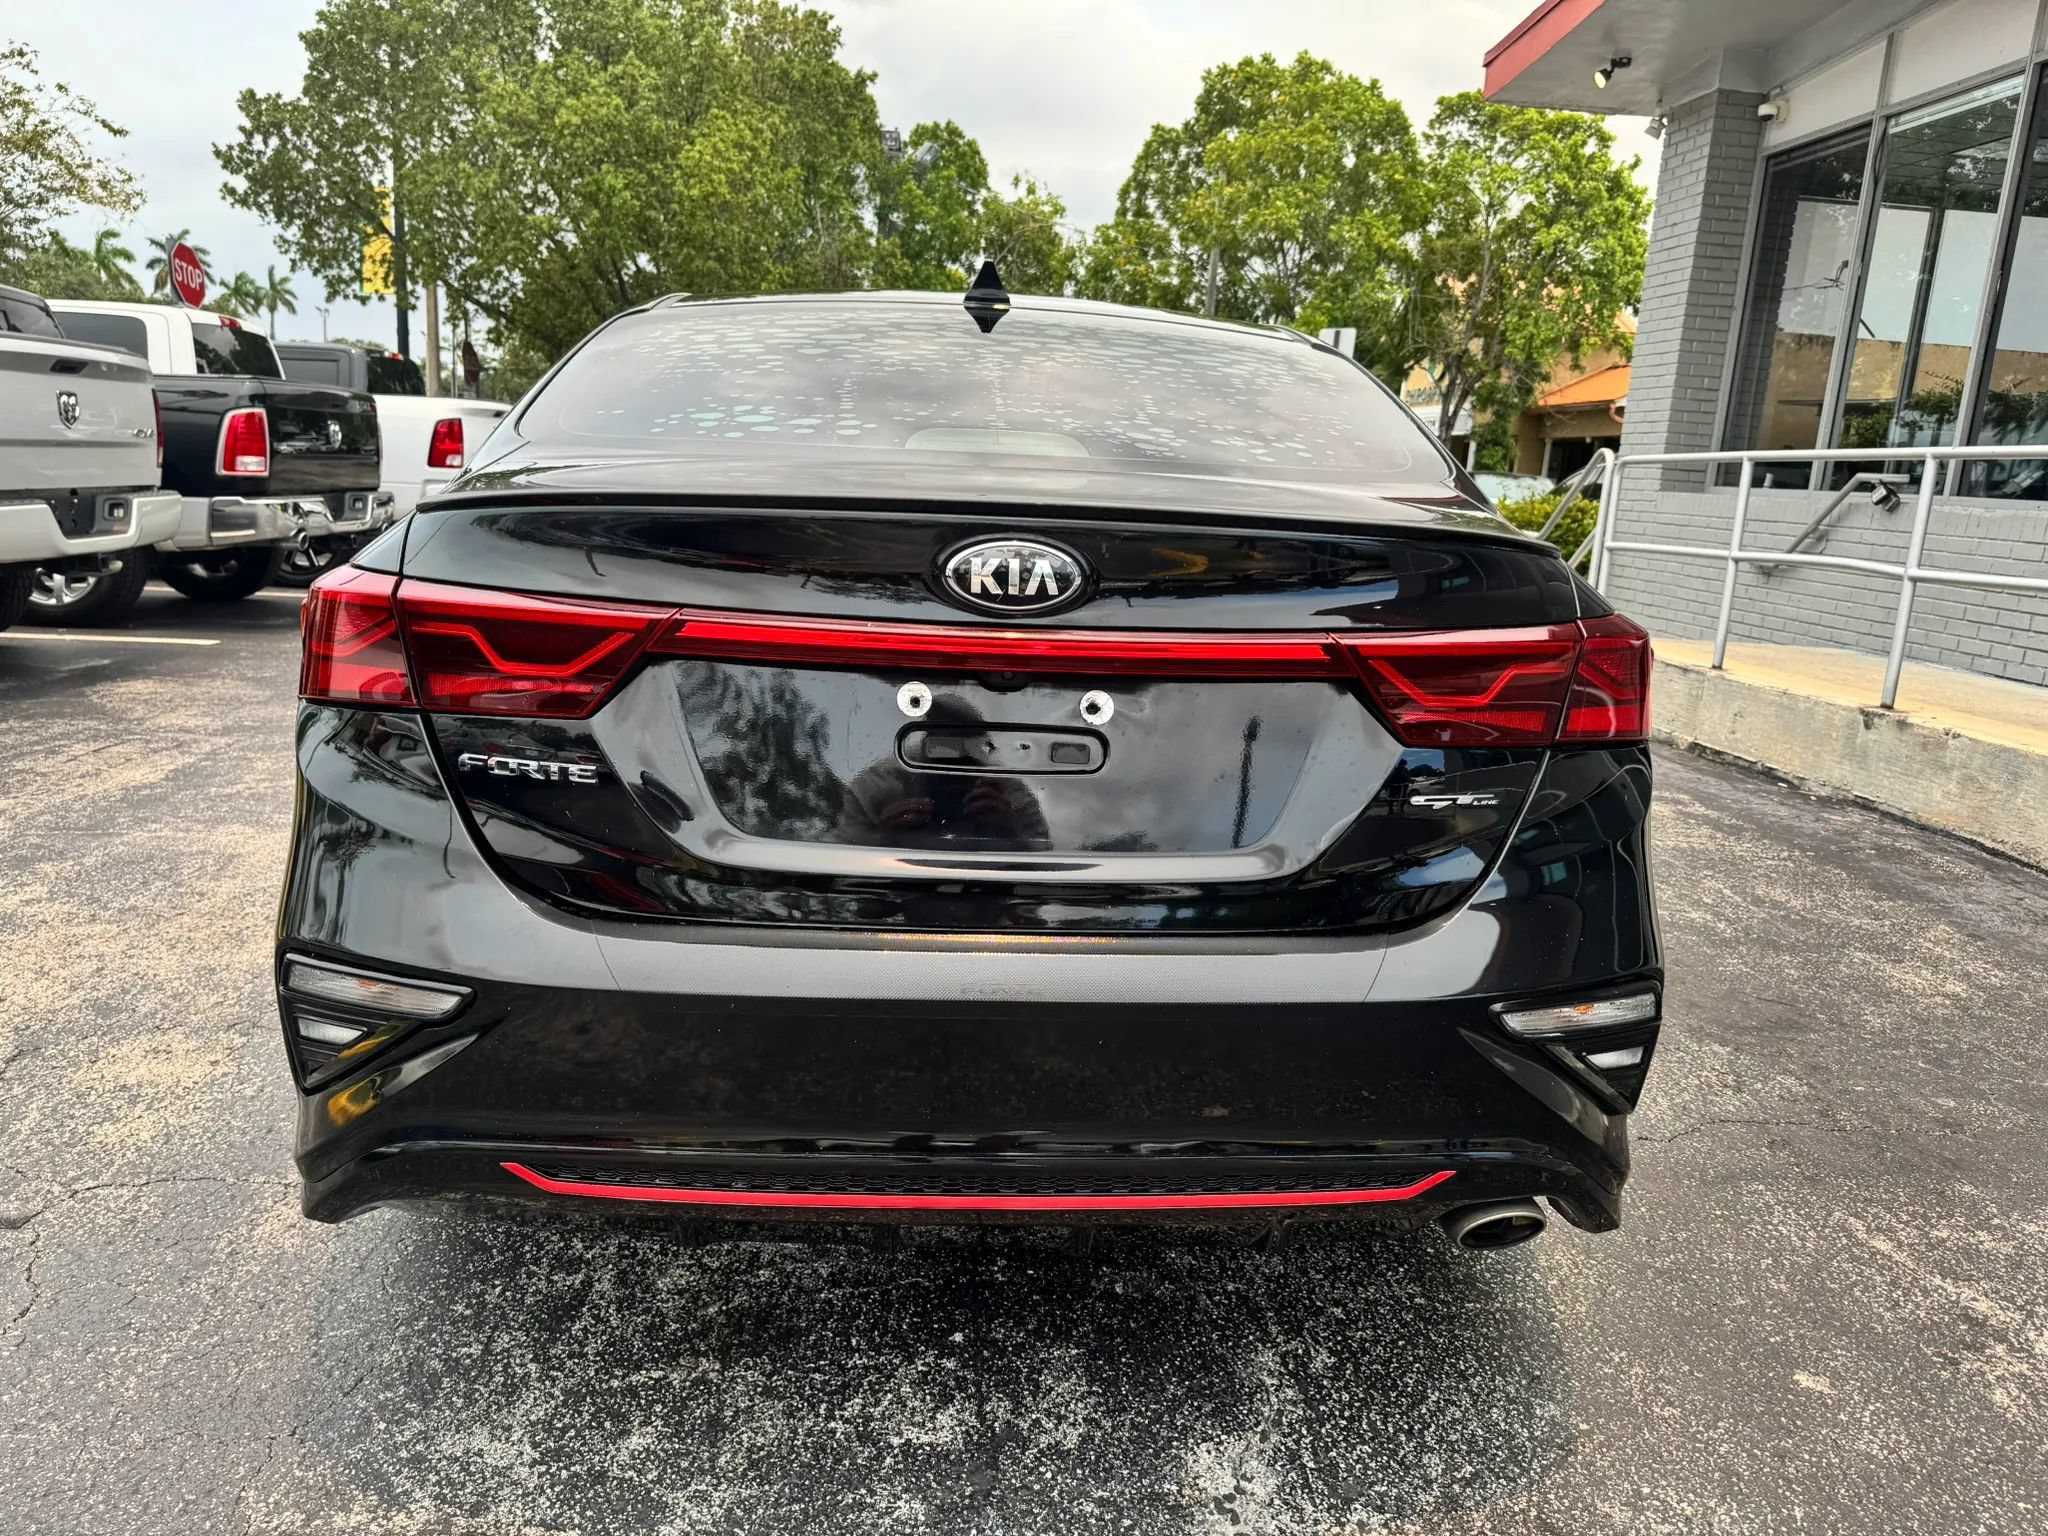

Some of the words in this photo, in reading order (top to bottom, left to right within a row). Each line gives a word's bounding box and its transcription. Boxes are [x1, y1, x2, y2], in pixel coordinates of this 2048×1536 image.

[175, 258, 203, 291] STOP
[969, 557, 1059, 596] KIA
[458, 753, 598, 784] FORTE
